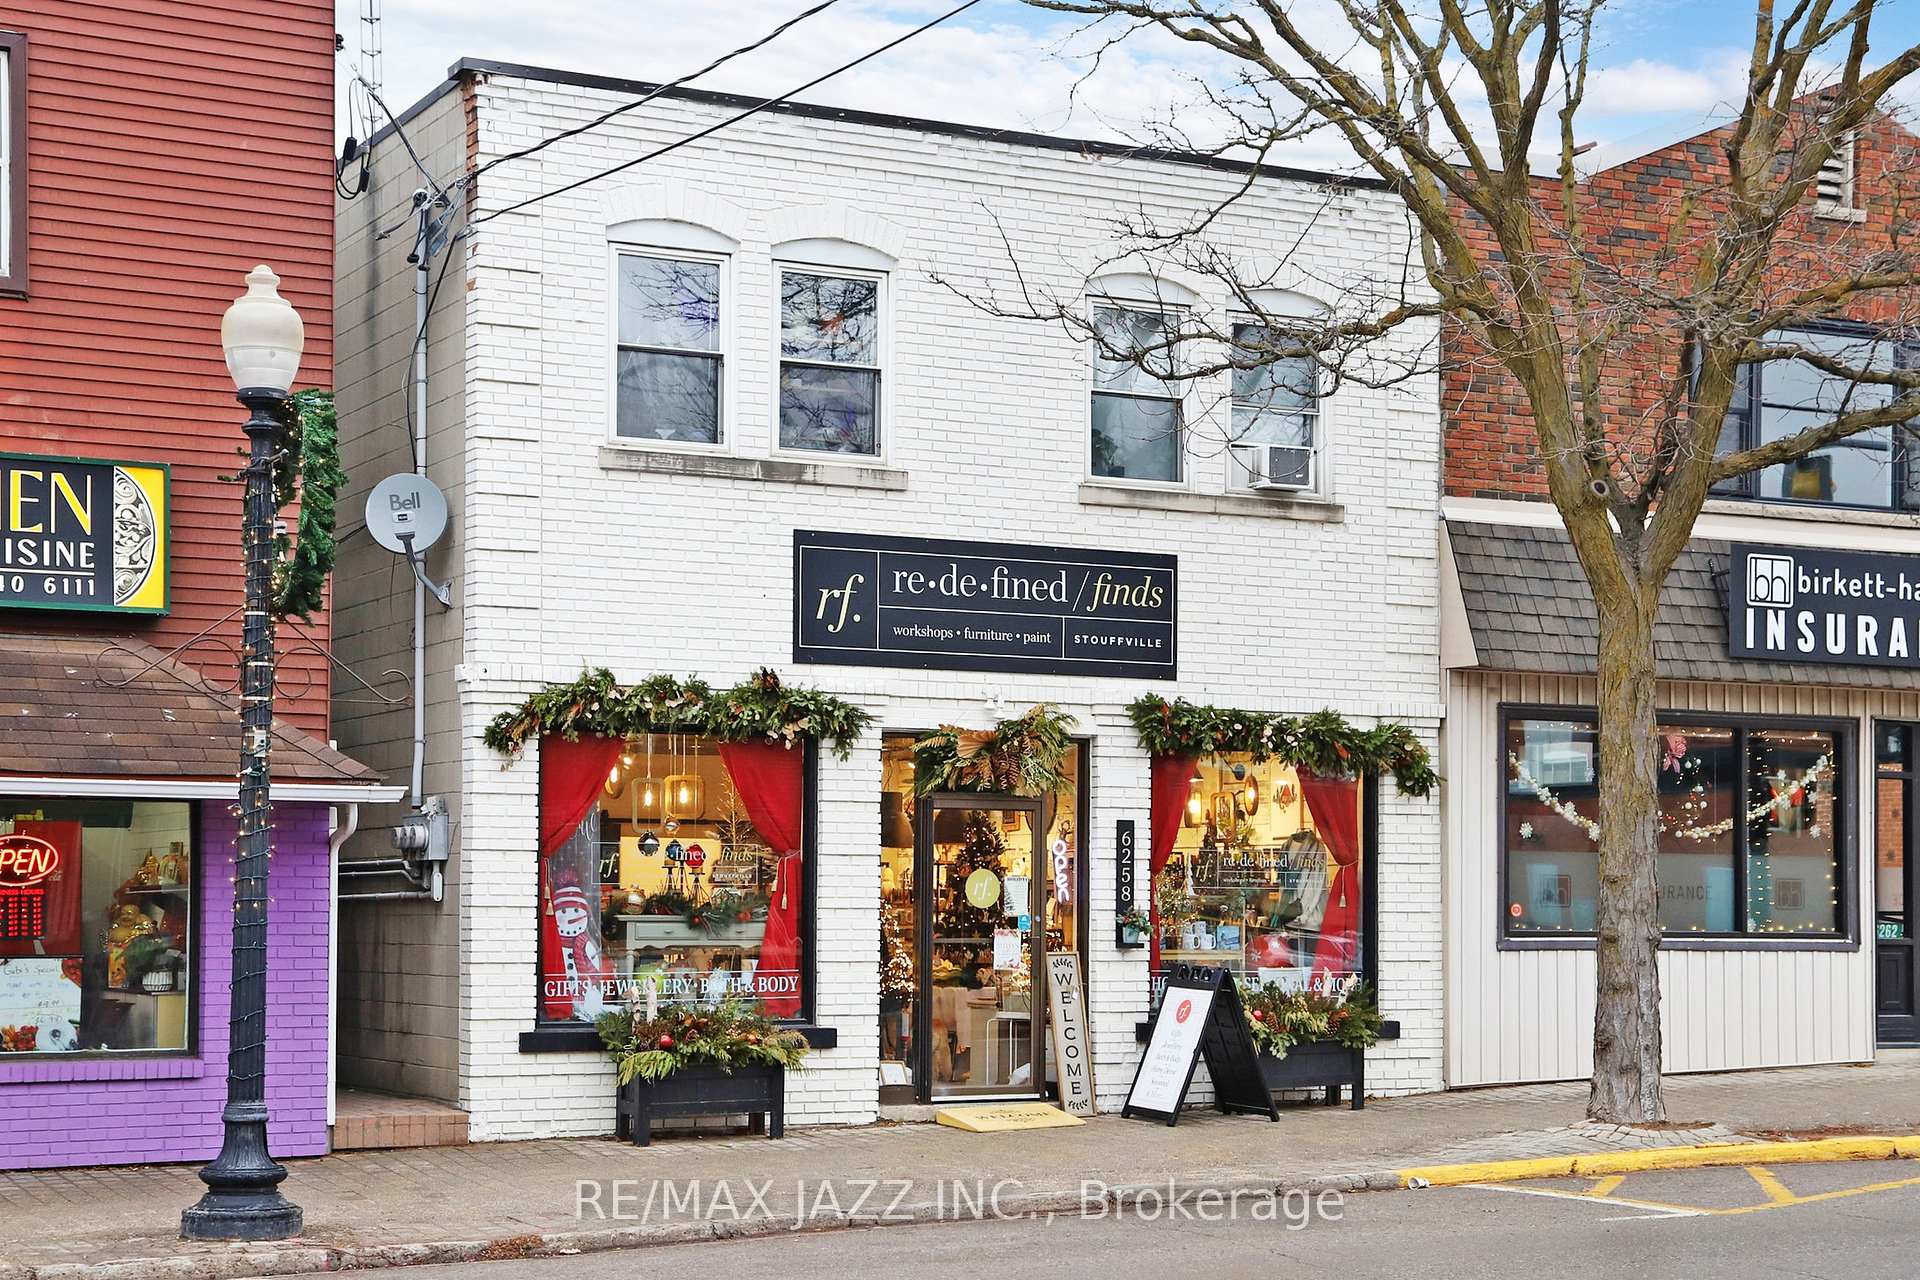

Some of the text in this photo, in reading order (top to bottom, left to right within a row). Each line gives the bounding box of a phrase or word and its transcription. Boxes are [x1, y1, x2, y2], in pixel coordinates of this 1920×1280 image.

[0, 469, 92, 536] EN
[389, 492, 421, 511] Bell
[5, 538, 95, 568] ISINE
[44, 577, 95, 596] 6111
[815, 573, 865, 633] rf.
[893, 624, 1051, 645] workshops furniture paint
[1074, 634, 1162, 648] STOUFFVILLE
[1746, 608, 1920, 658] INSURA
[1121, 831, 1132, 902] 6258
[700, 977, 741, 994] BTH
[758, 976, 799, 992] BODY
[1054, 973, 1083, 1095] WELCOME
